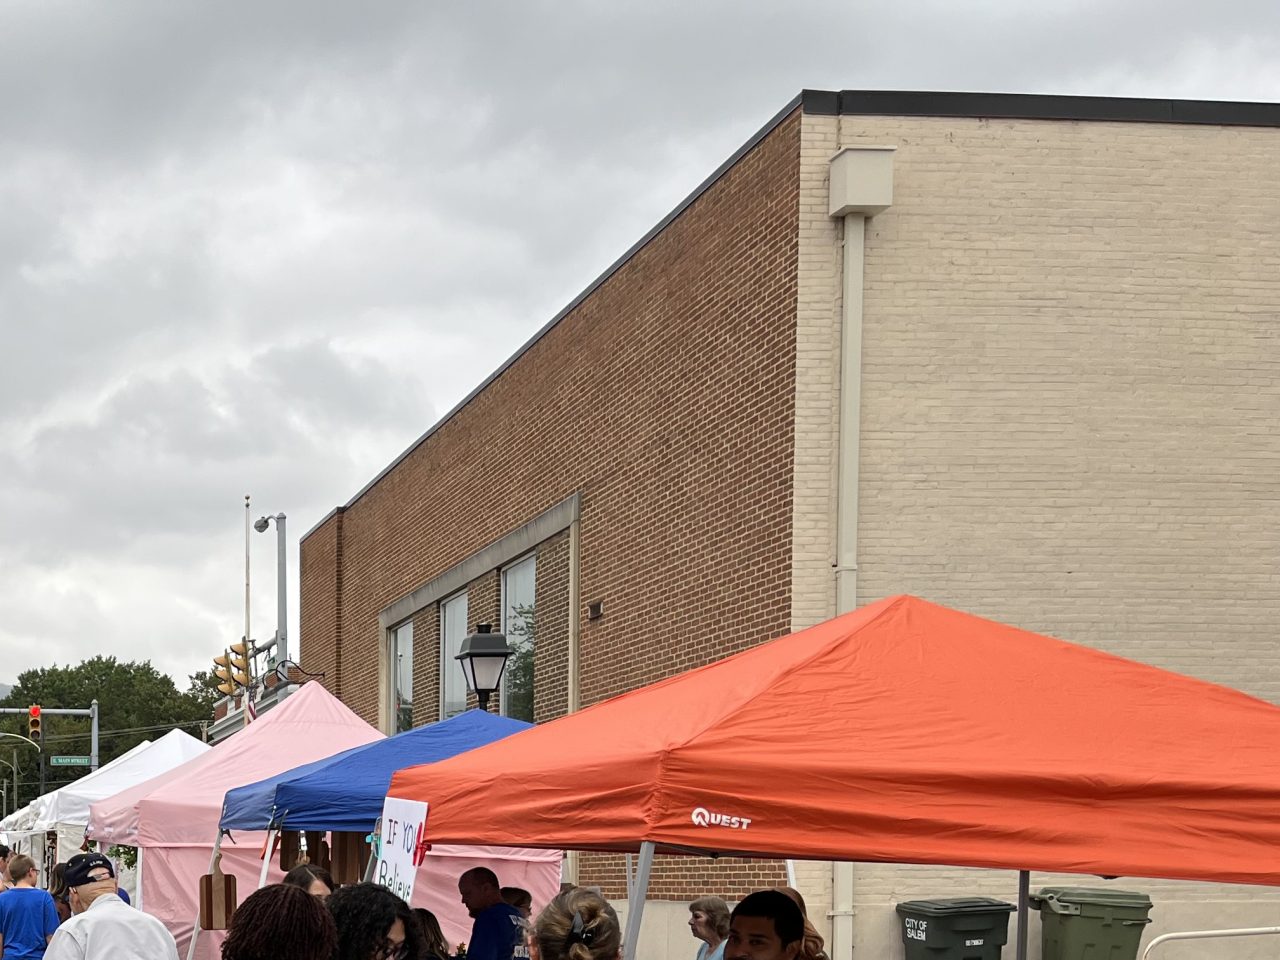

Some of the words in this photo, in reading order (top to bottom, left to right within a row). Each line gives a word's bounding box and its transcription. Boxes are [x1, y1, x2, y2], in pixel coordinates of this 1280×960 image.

[691, 807, 752, 830] QUEST
[386, 819, 398, 846] IF
[905, 918, 918, 929] CITY
[919, 920, 928, 930] OF
[906, 928, 926, 941] SALEM
